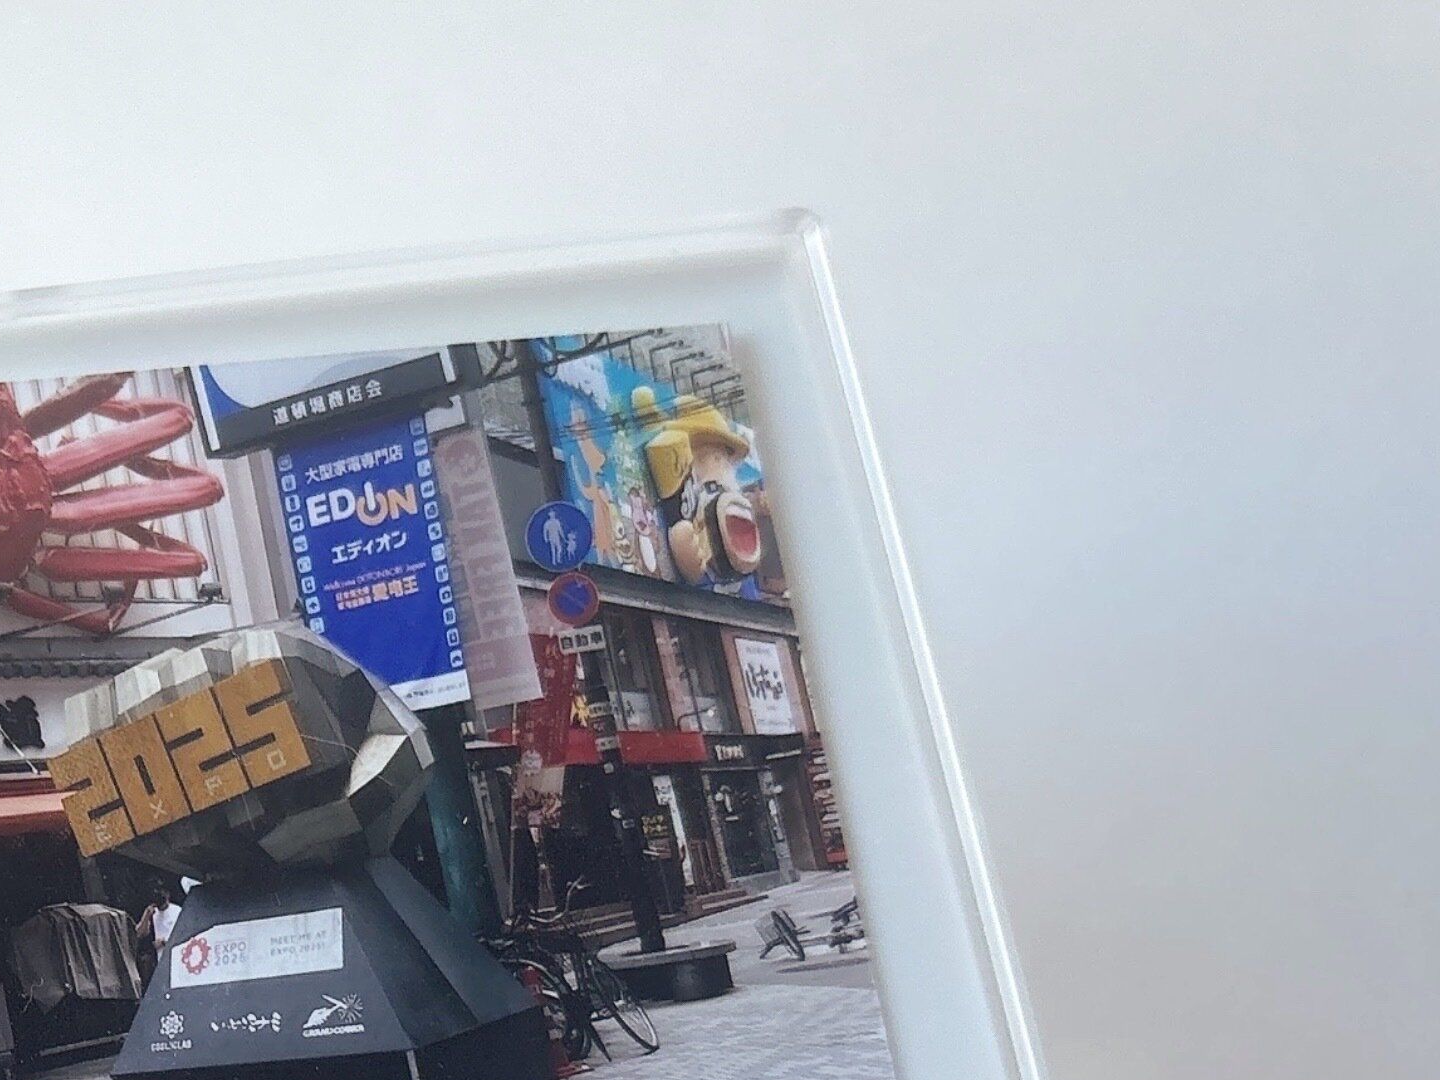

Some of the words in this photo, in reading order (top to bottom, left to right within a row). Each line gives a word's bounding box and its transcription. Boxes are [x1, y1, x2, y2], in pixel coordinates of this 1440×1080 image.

[305, 480, 418, 527] EDION
[331, 530, 407, 565] エディオン
[560, 630, 602, 651] 自動車
[47, 658, 311, 858] 2025
[214, 941, 247, 956] EXPO
